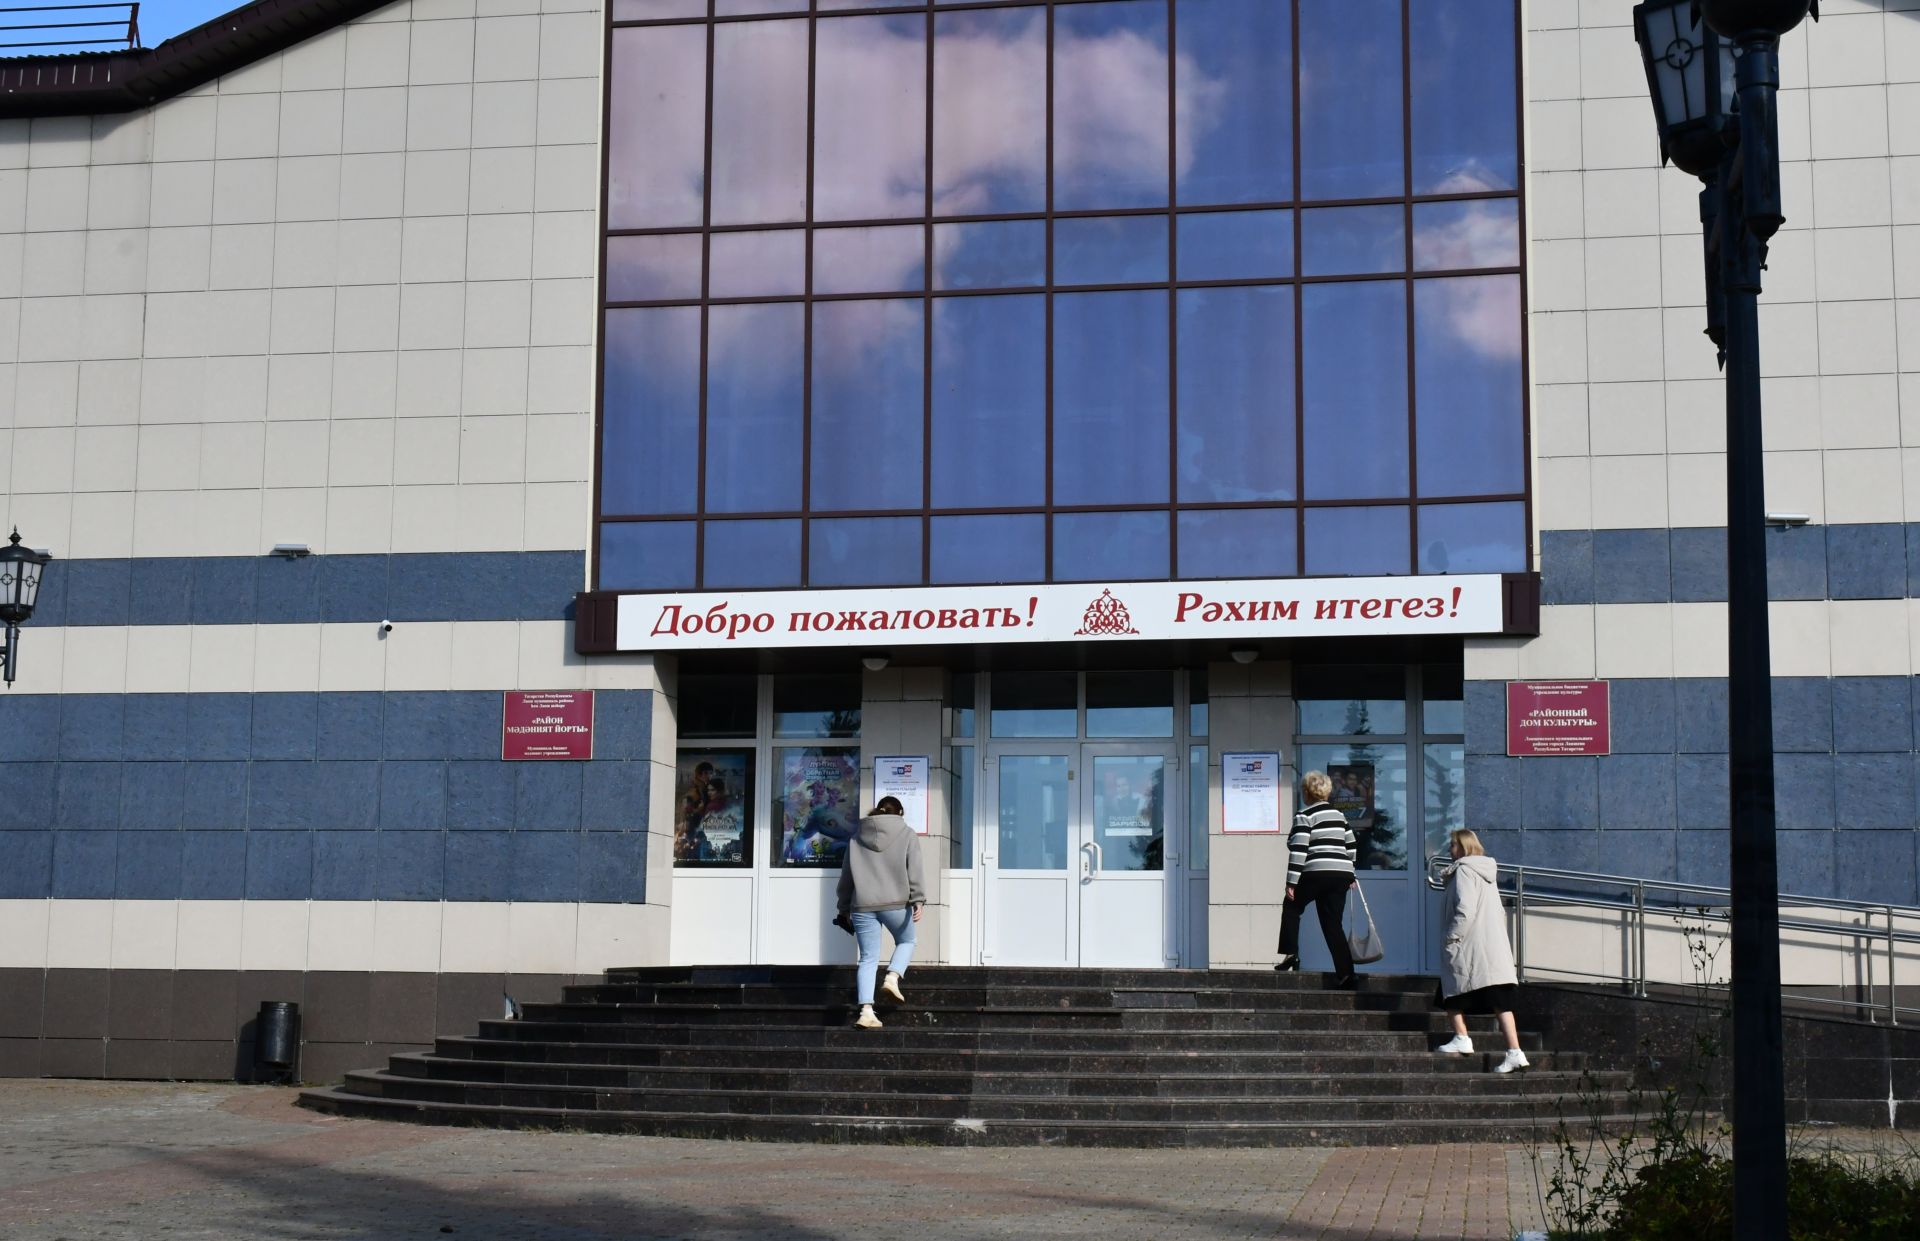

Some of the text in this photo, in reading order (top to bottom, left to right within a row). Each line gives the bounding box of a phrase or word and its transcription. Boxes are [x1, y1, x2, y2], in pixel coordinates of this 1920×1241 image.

[1174, 586, 1463, 623] Рәхим итегез!
[650, 596, 1038, 640] Добро пожаловать!
[1529, 708, 1588, 717] «РАЙОННЫЙ
[532, 715, 563, 724] «РАЙОН
[1520, 718, 1597, 727] ДОМ КУЛЬТУРЫ»
[507, 725, 588, 734] МӘДӘНИЯТ ЙОРТЫ»
